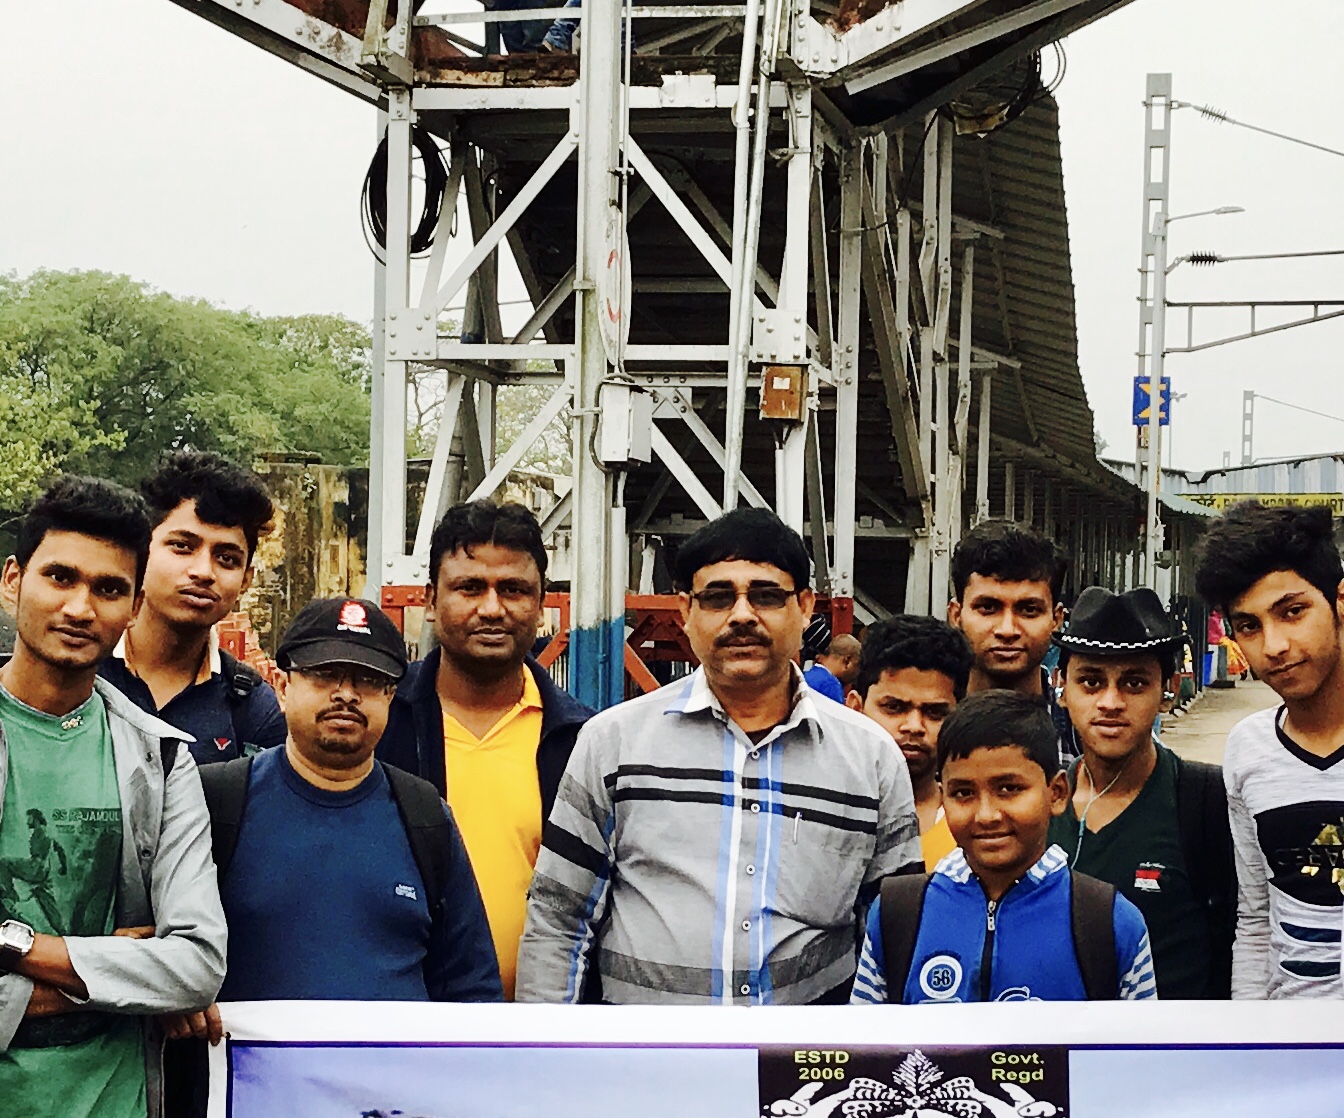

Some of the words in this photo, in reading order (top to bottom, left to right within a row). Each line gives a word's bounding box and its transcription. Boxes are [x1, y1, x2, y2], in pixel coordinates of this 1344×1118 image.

[794, 1051, 849, 1064] ESTD
[991, 1052, 1045, 1065] Govt.
[798, 1067, 845, 1081] 2006
[991, 1068, 1044, 1083] Regd
